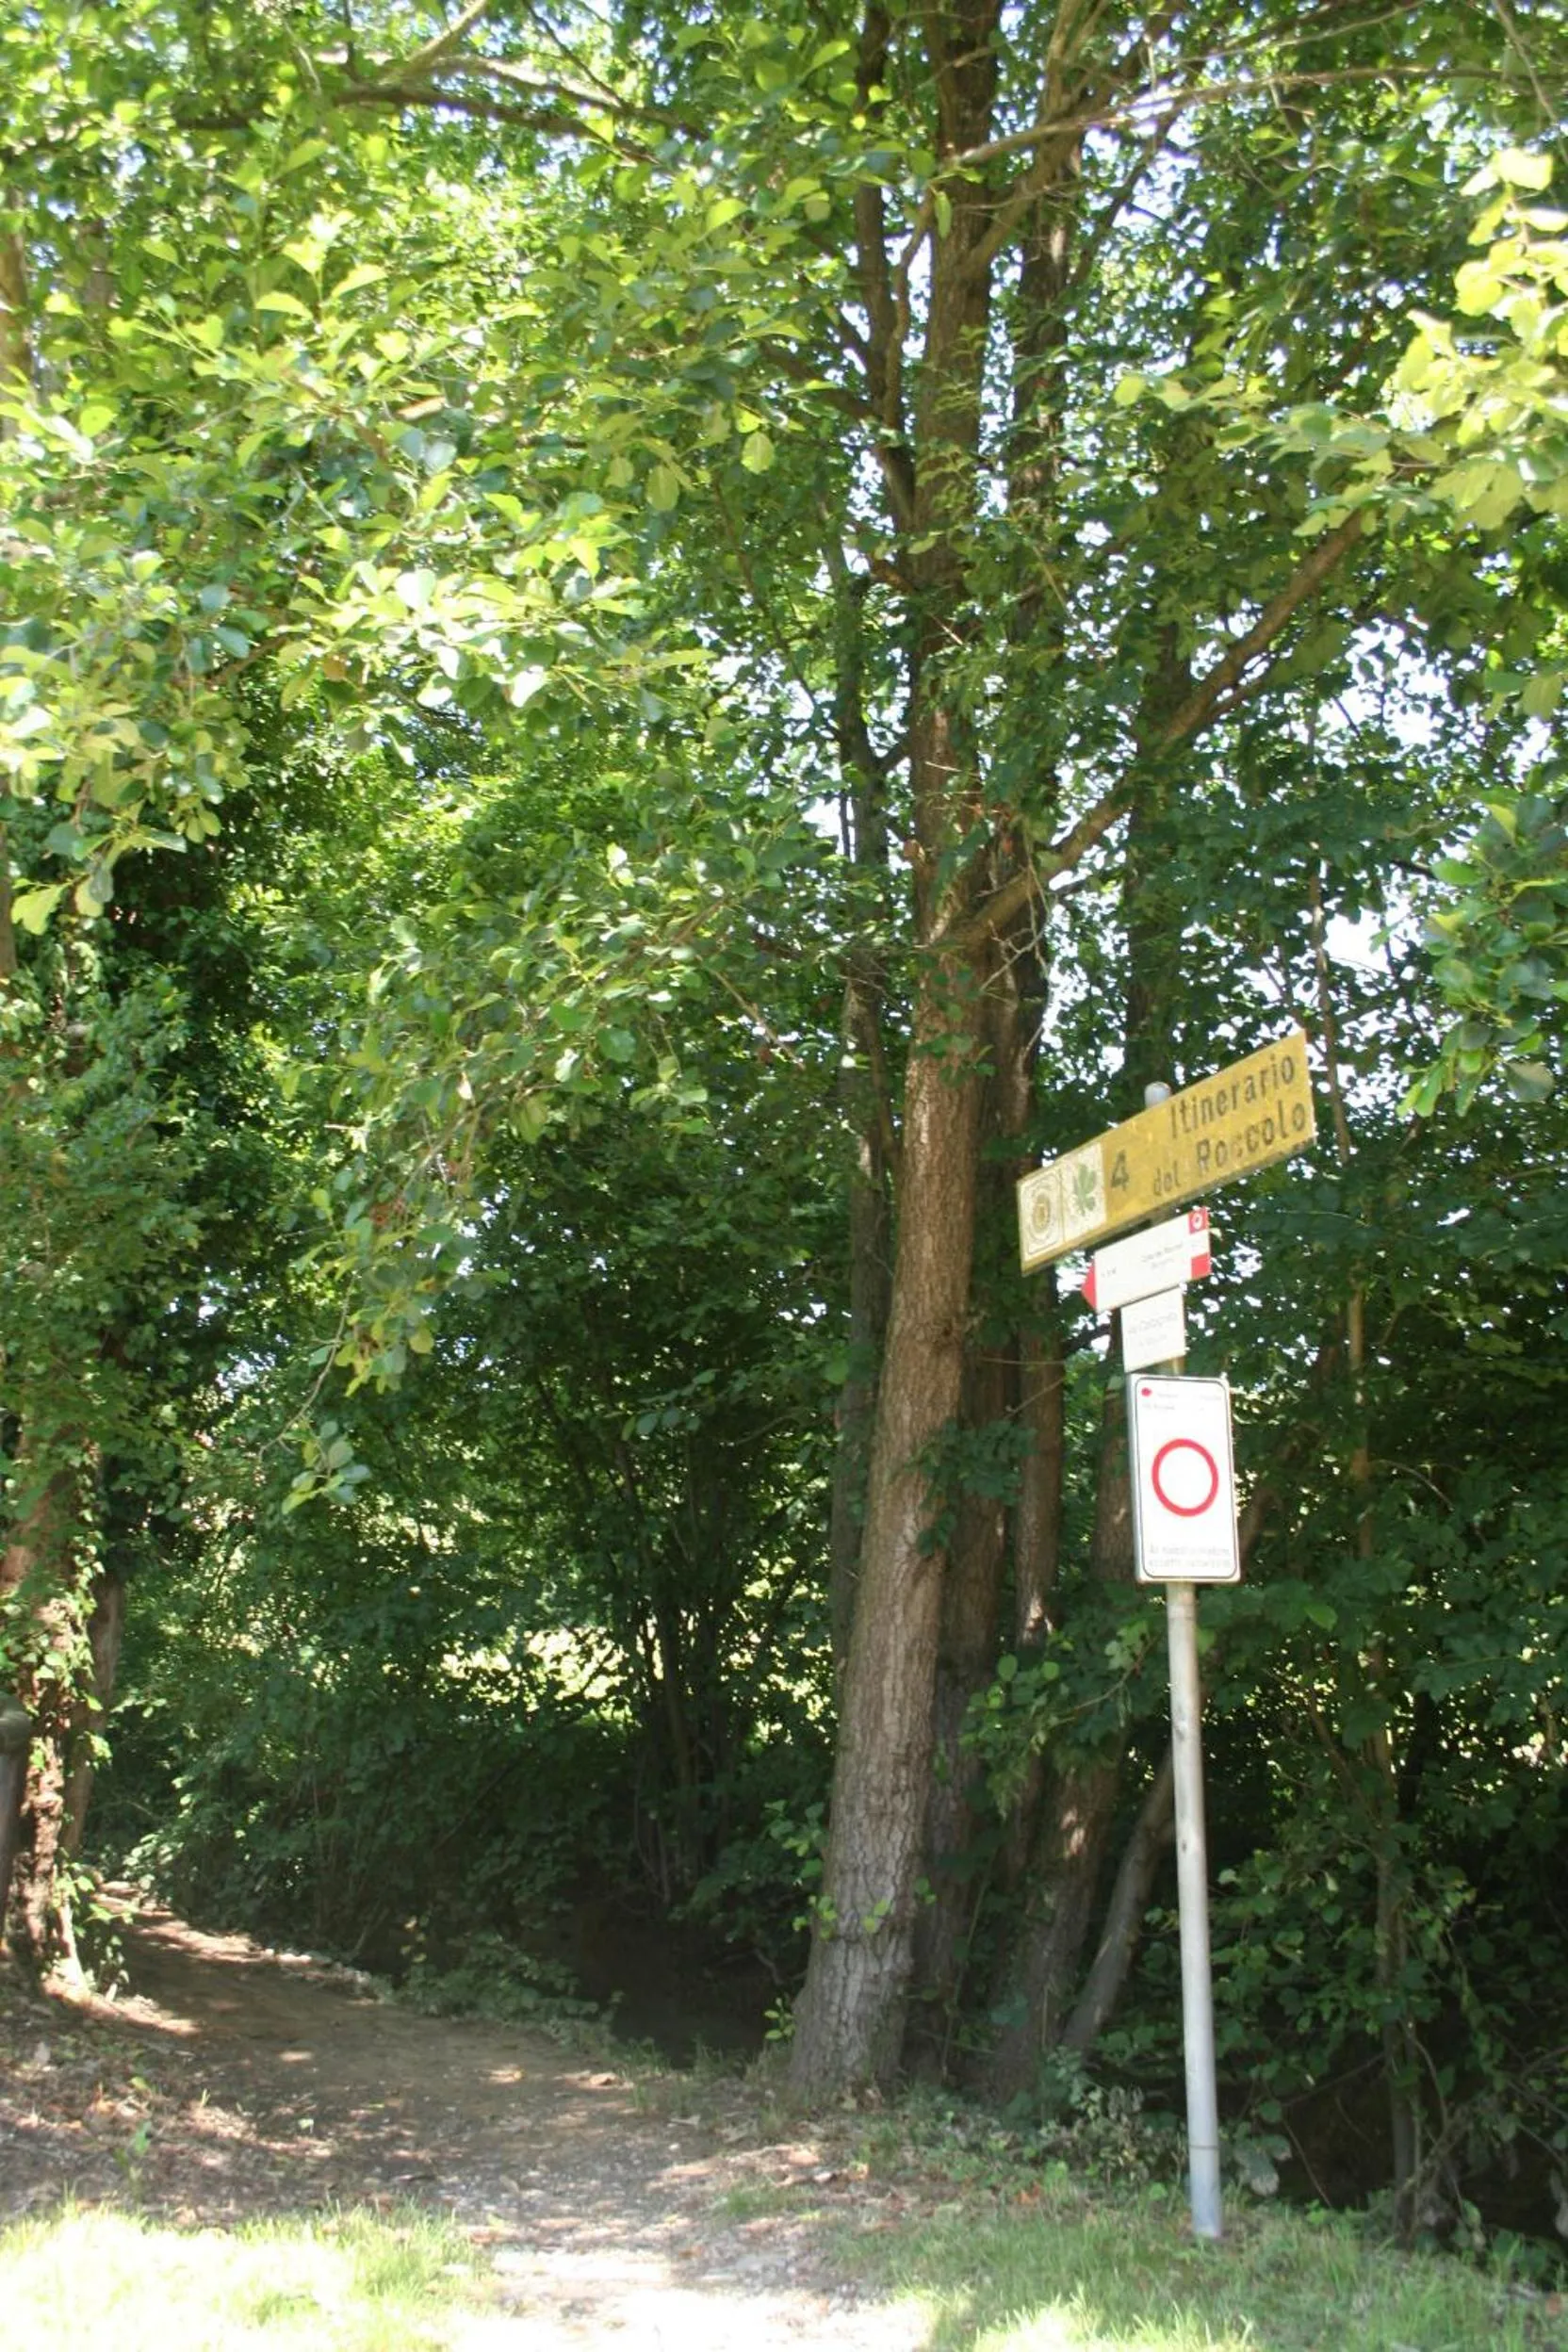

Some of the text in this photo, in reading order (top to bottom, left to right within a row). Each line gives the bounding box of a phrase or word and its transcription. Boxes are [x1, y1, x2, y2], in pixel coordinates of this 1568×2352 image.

[1169, 1054, 1296, 1140] Itinerario
[1110, 1149, 1130, 1192] 4
[1152, 1160, 1182, 1198] del
